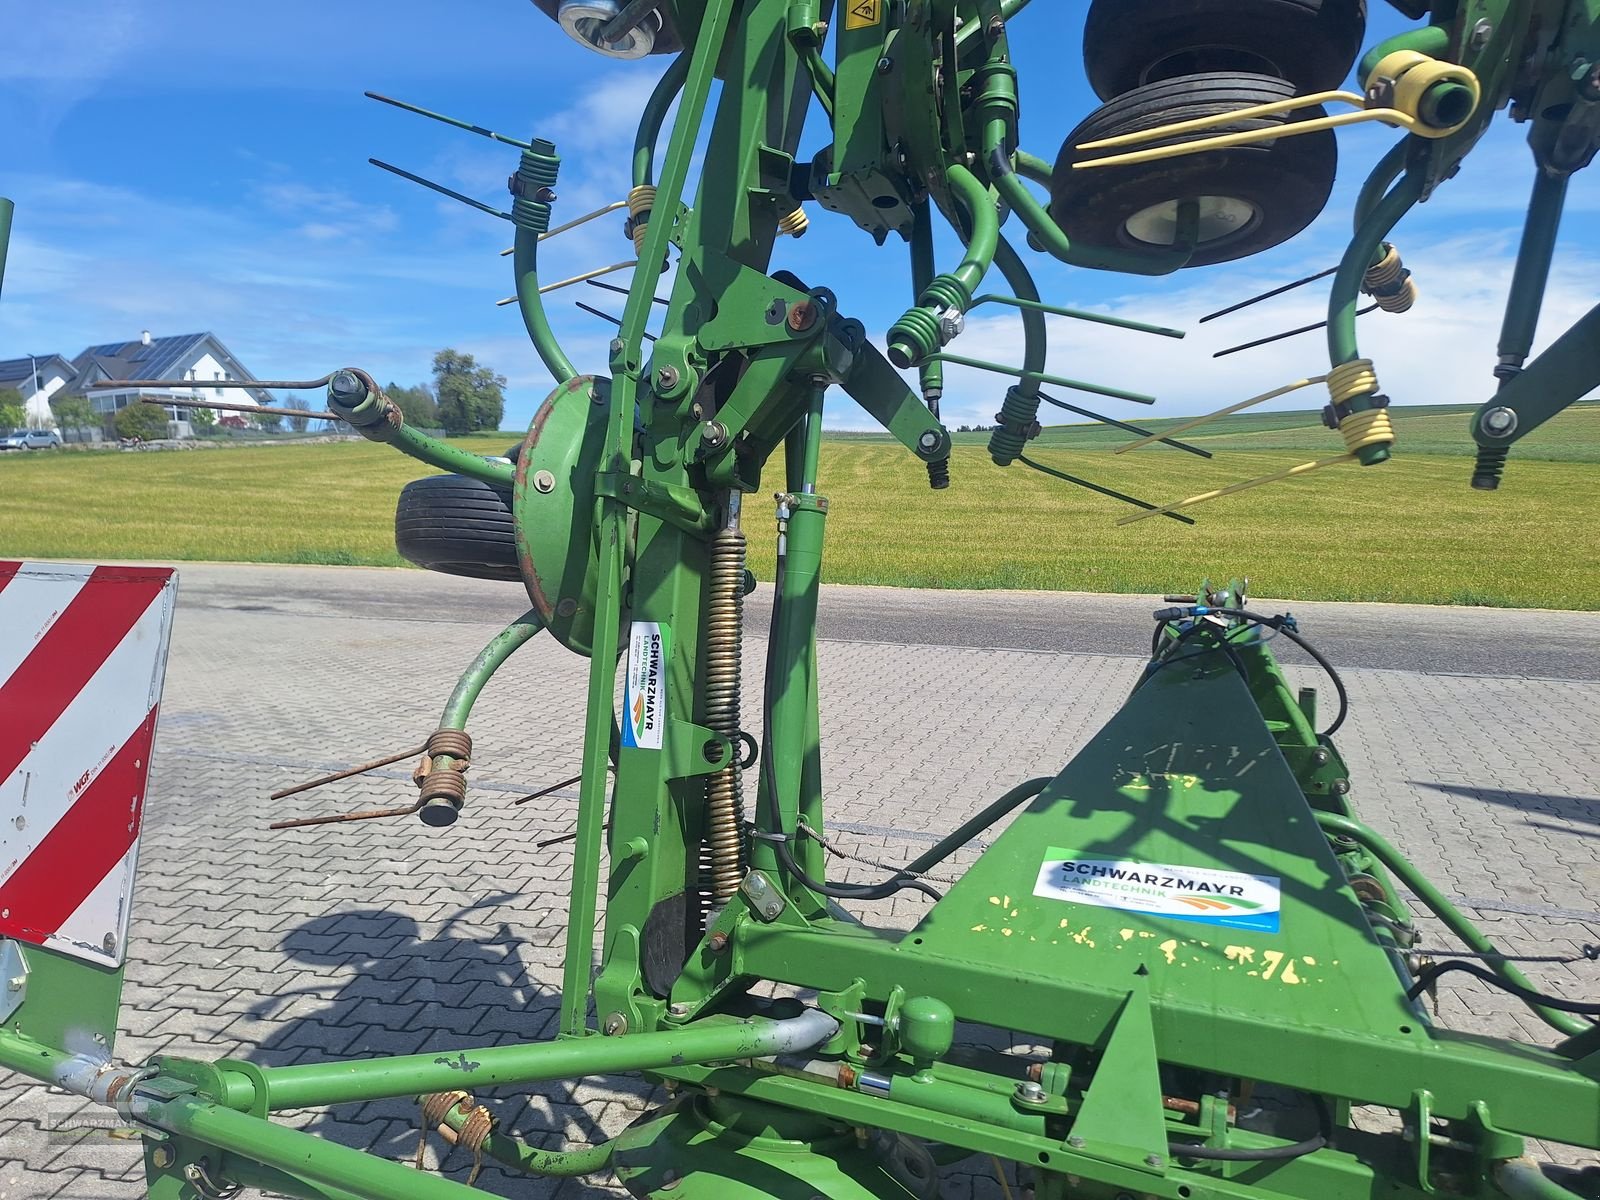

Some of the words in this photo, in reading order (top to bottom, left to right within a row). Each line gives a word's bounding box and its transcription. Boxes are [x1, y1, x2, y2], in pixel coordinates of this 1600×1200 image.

[640, 635, 650, 691] LANDTECHNIK
[645, 634, 660, 730] SCHWARZMAYR
[73, 769, 90, 794] WGF
[1061, 862, 1244, 896] SCHWARZMAYR
[1063, 875, 1167, 897] LANDTECHNIK
